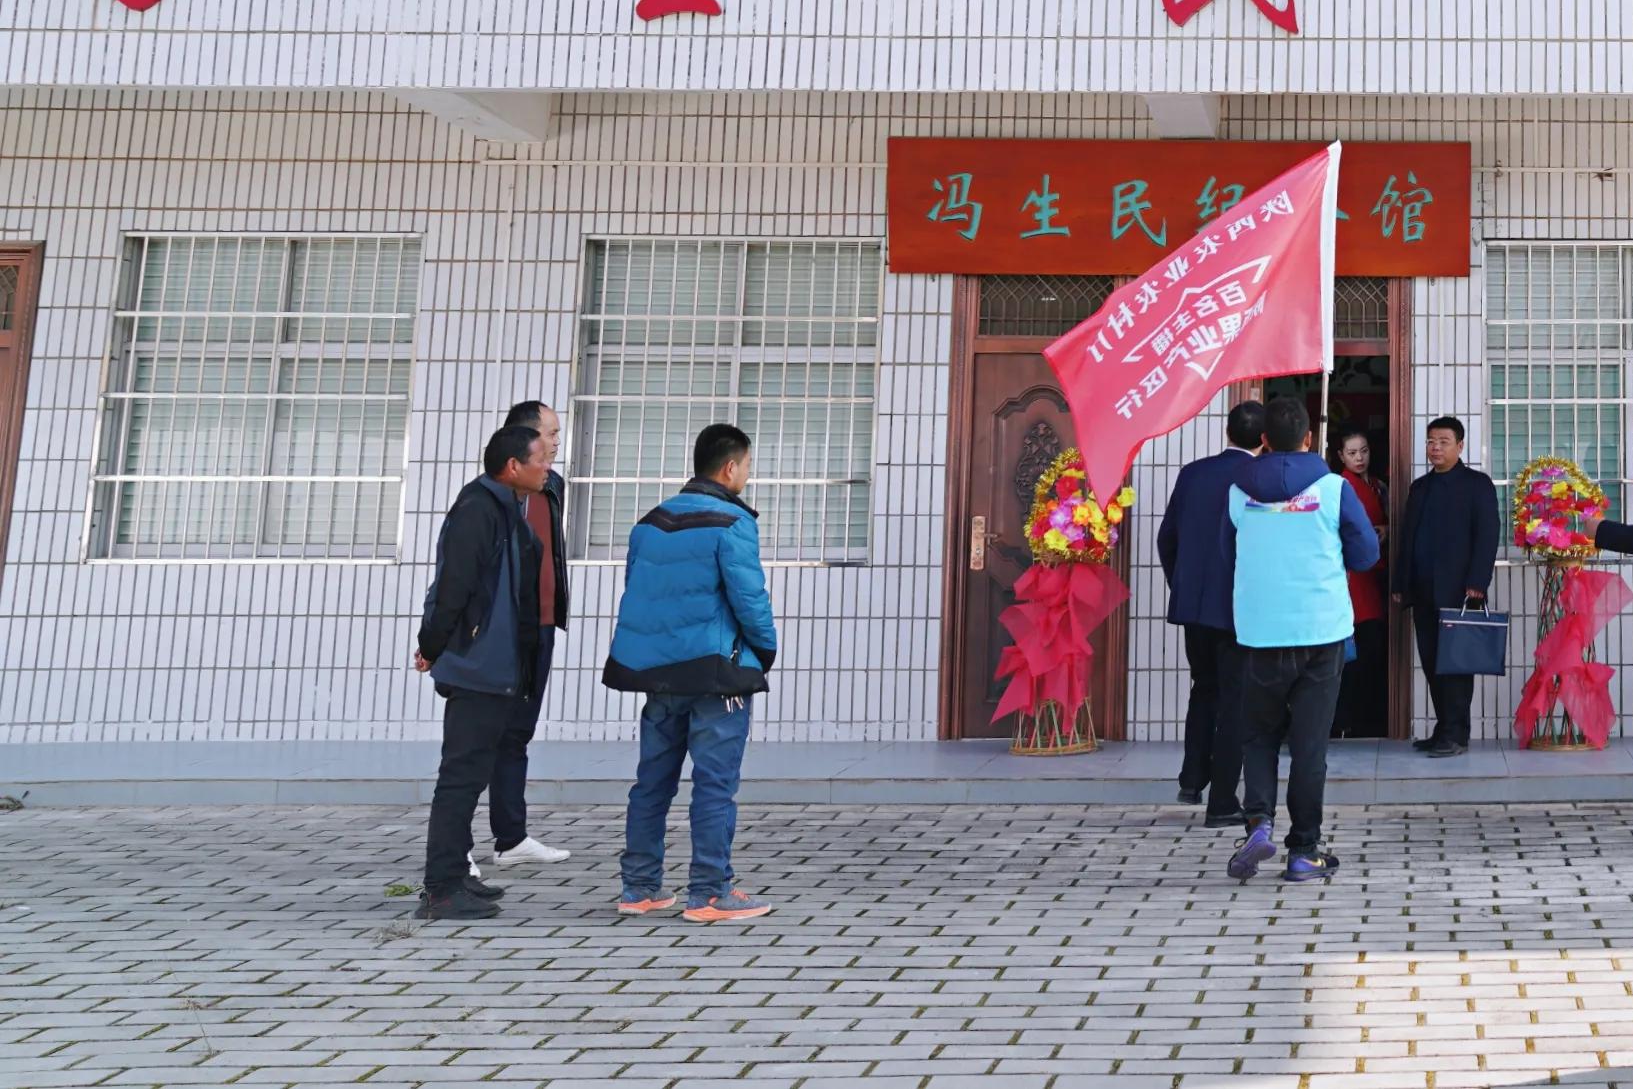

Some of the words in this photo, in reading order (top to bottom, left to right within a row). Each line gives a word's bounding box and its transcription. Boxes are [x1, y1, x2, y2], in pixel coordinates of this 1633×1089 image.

[926, 170, 1433, 246] 冯生民纪馆
